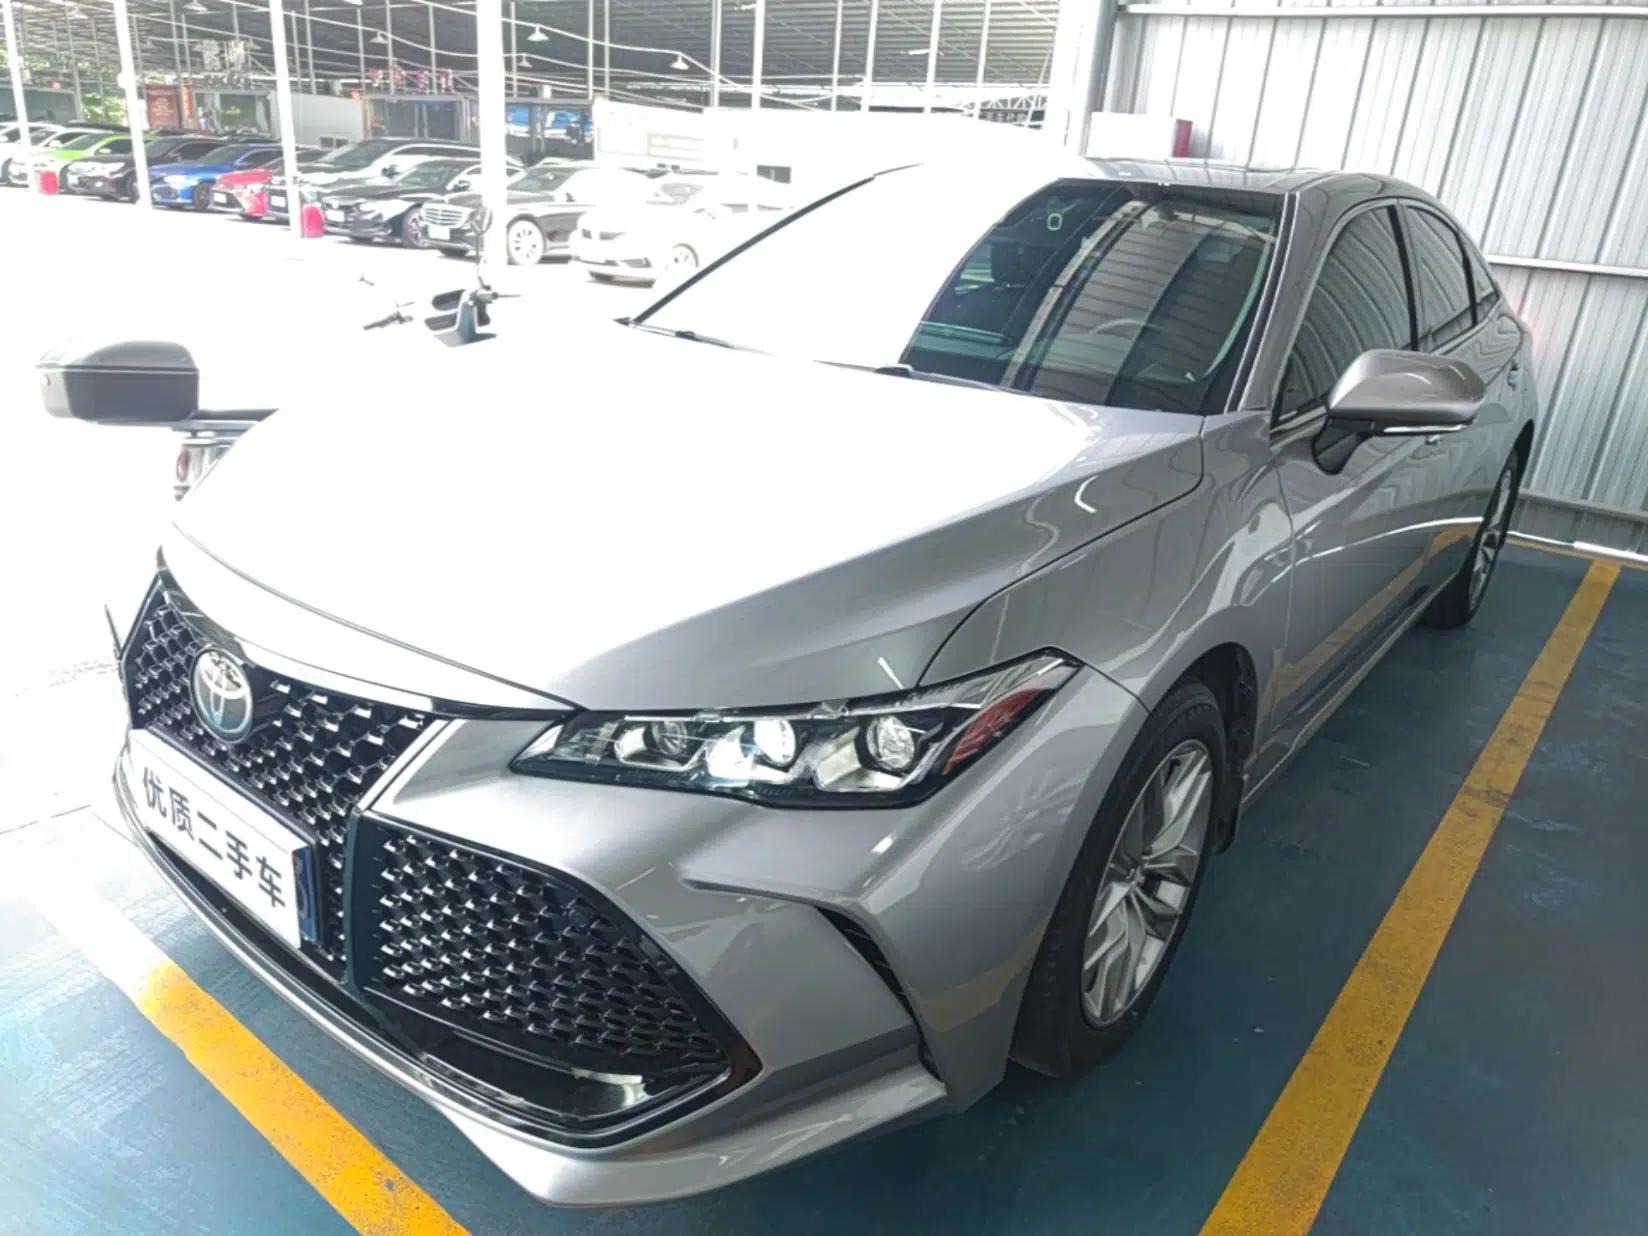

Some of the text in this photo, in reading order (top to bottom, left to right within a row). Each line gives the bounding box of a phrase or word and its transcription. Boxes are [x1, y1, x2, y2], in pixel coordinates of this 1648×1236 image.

[143, 766, 286, 909] 优质二手车
